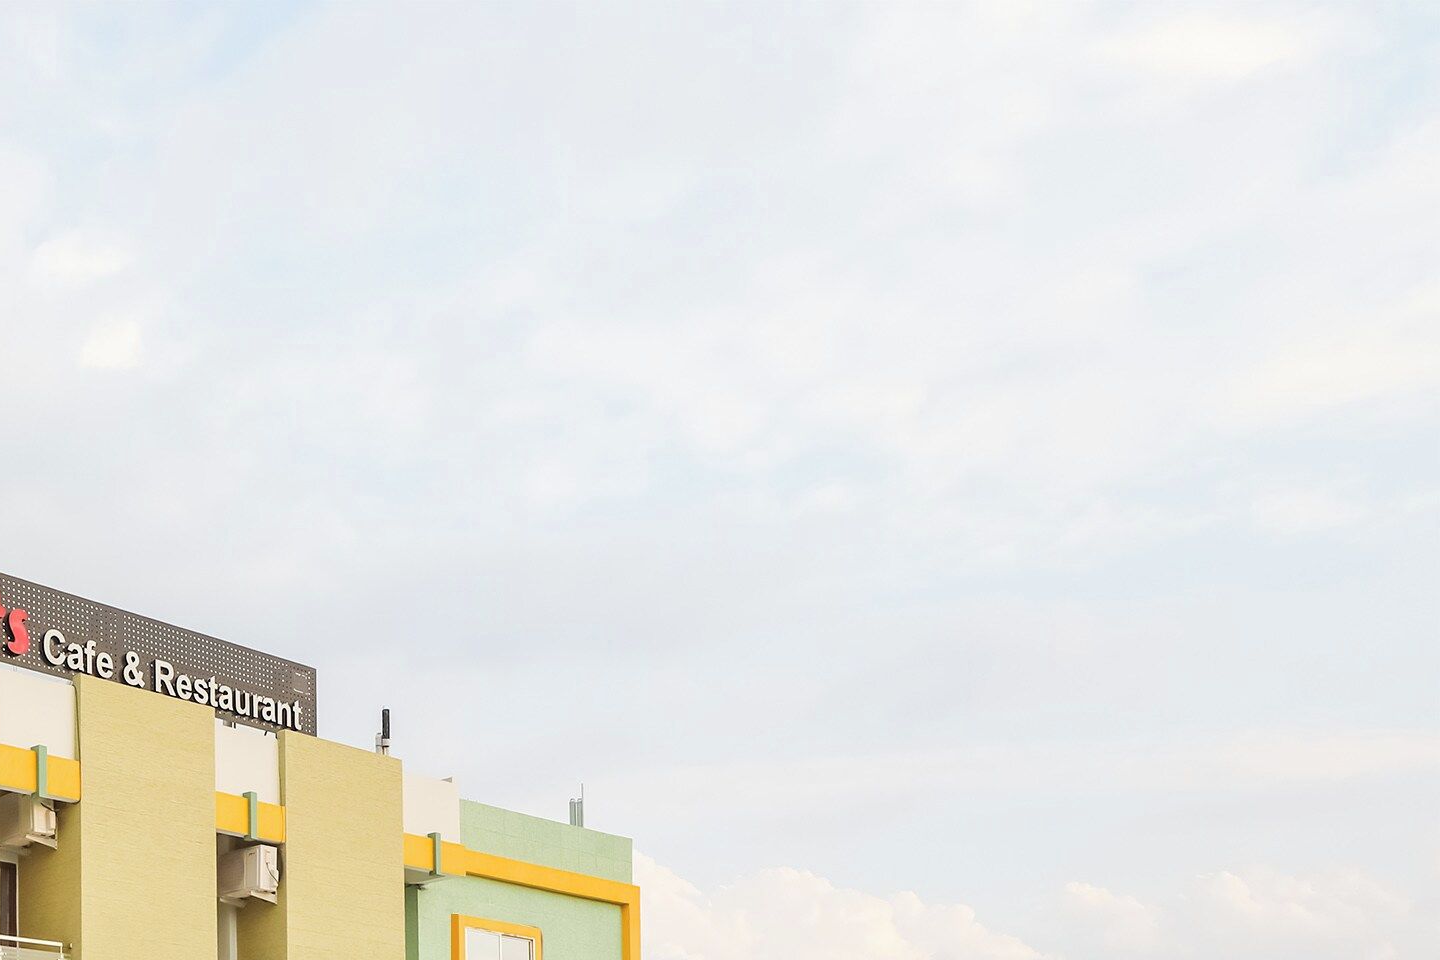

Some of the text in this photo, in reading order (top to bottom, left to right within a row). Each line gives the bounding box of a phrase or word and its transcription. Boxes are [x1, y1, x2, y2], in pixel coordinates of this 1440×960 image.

[43, 628, 303, 731] Cafe & Restaurant
